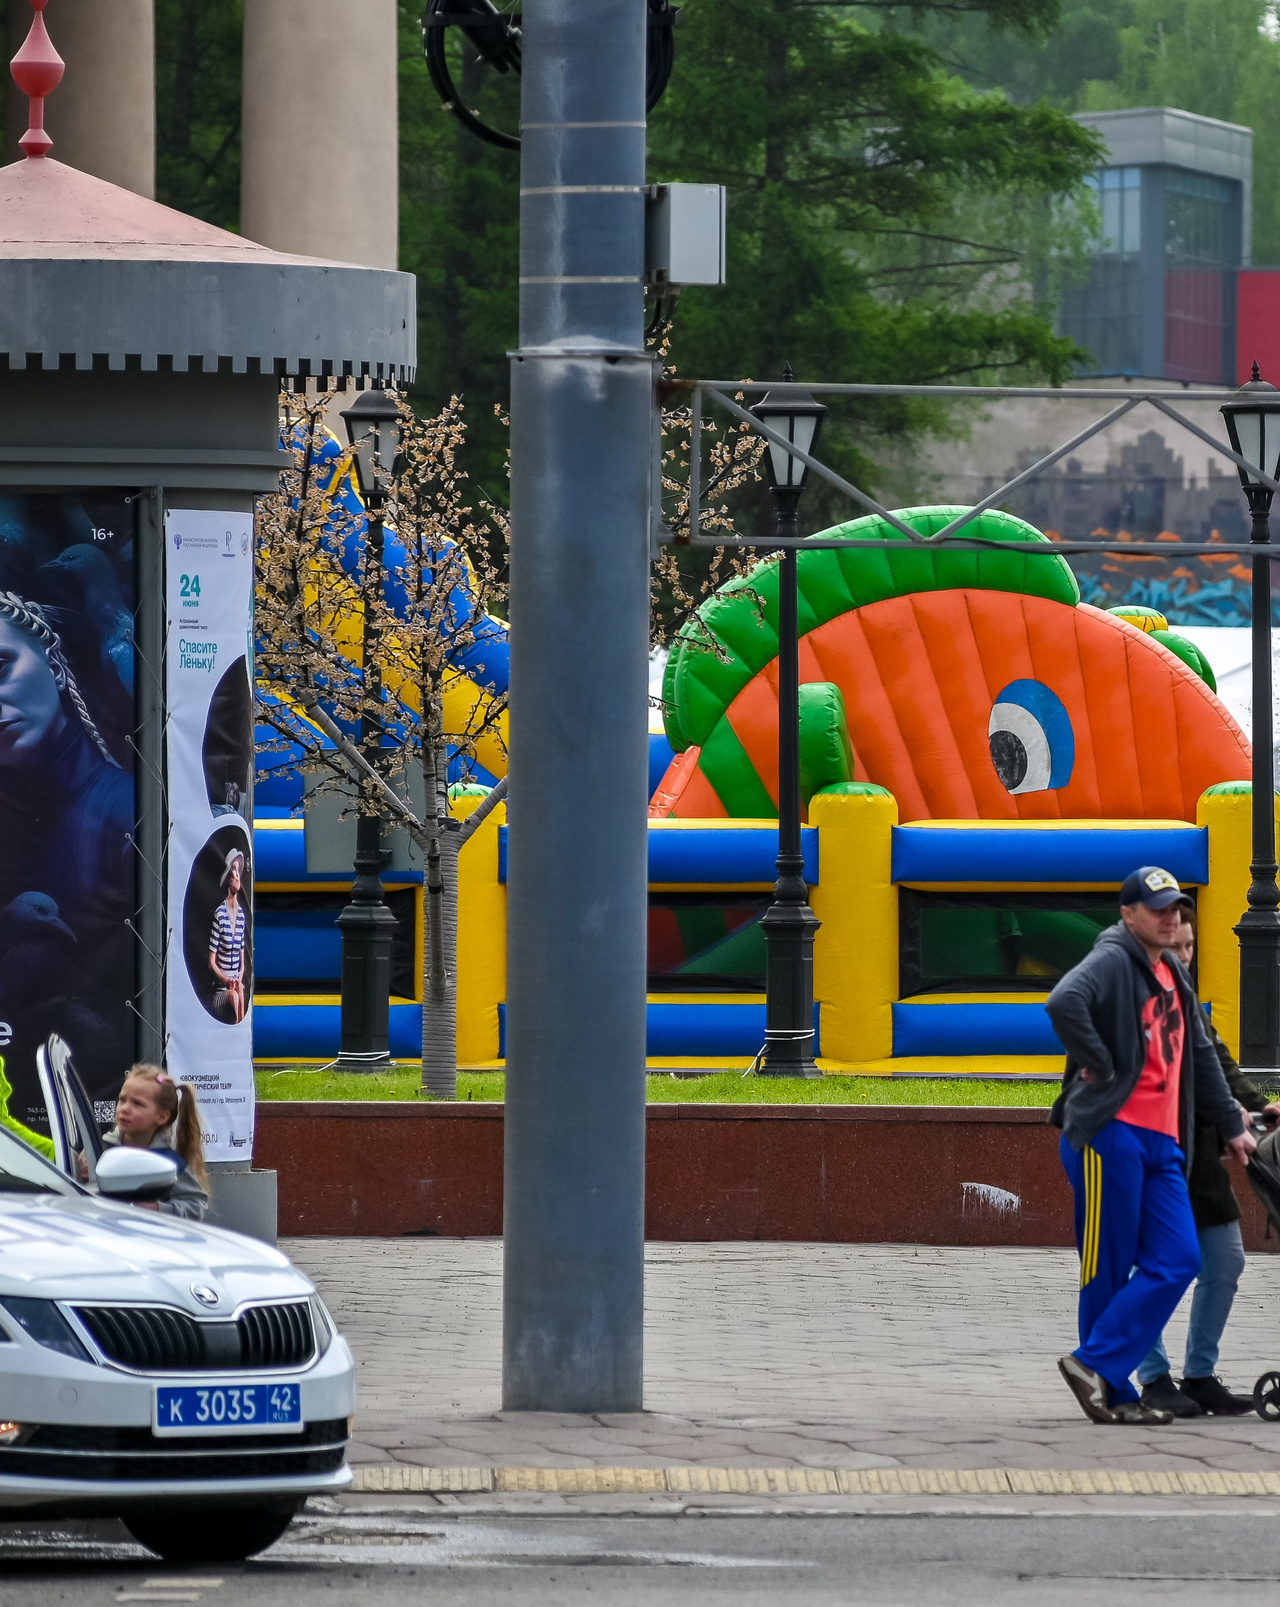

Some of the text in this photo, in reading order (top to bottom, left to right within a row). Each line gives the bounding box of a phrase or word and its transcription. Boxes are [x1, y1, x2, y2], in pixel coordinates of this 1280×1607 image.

[91, 528, 114, 540] 16+
[180, 574, 201, 597] 24
[179, 638, 218, 654] Спасите
[179, 654, 215, 673] Лёньку!
[195, 1388, 256, 1422] 3035
[270, 1386, 292, 1412] 42
